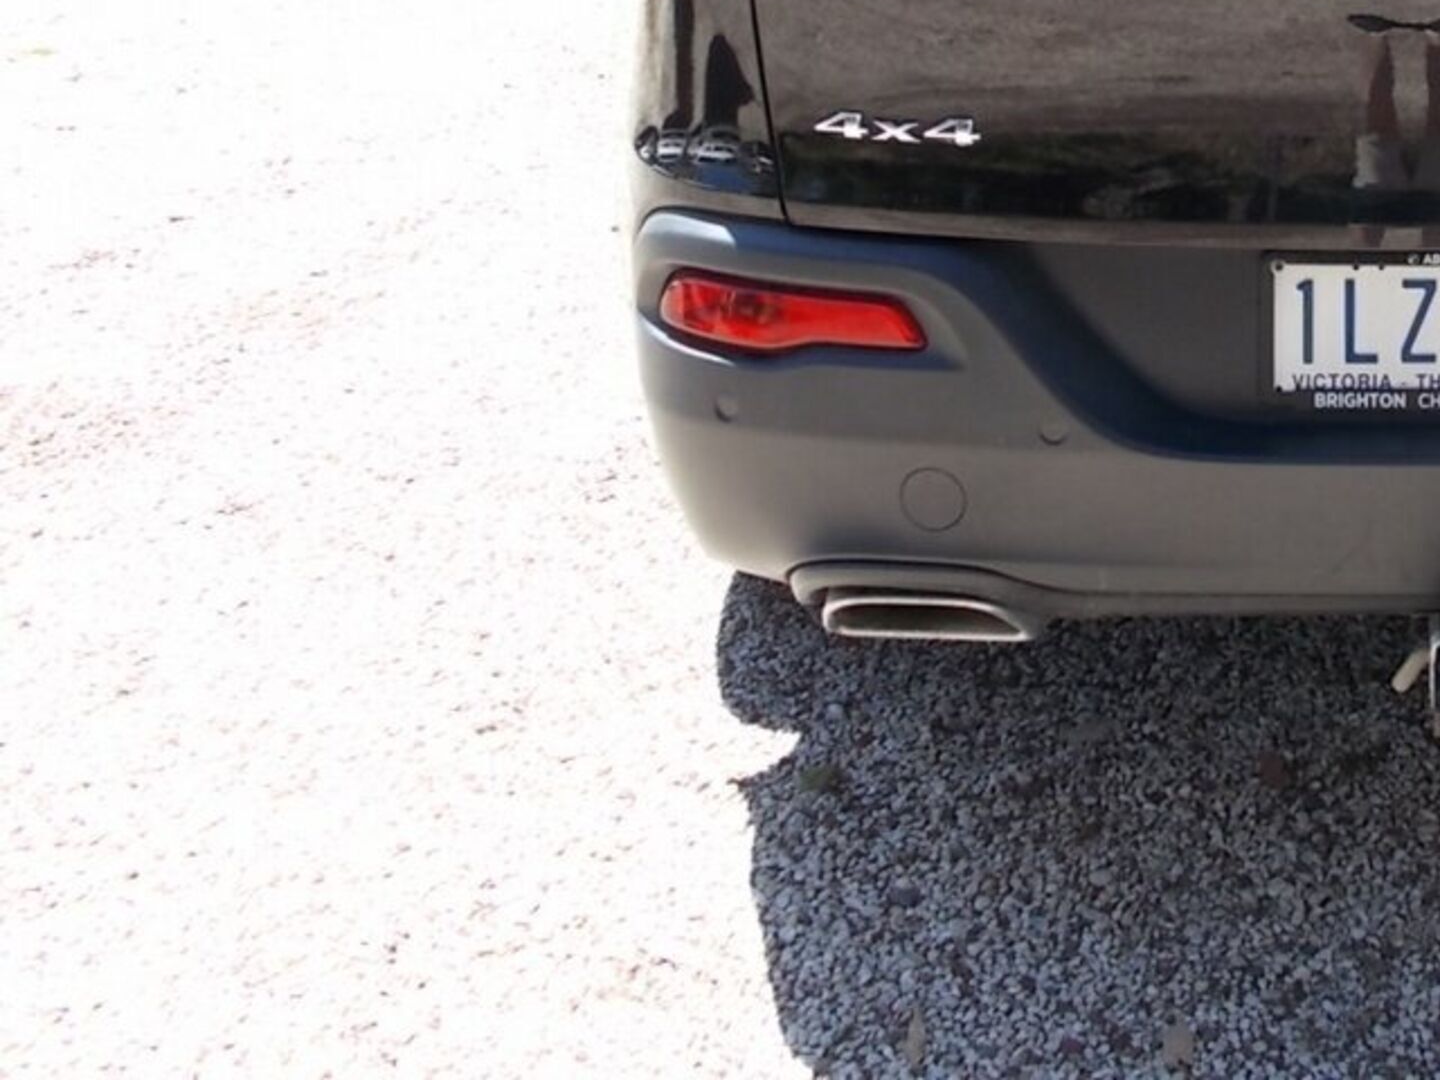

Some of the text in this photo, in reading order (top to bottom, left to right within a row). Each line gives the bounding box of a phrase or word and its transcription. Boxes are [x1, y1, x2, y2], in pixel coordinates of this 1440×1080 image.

[814, 111, 982, 147] 4x4
[1297, 279, 1437, 365] 1LZ
[1292, 373, 1392, 390] VICTORIA
[1314, 392, 1406, 408] BRIGHTON
